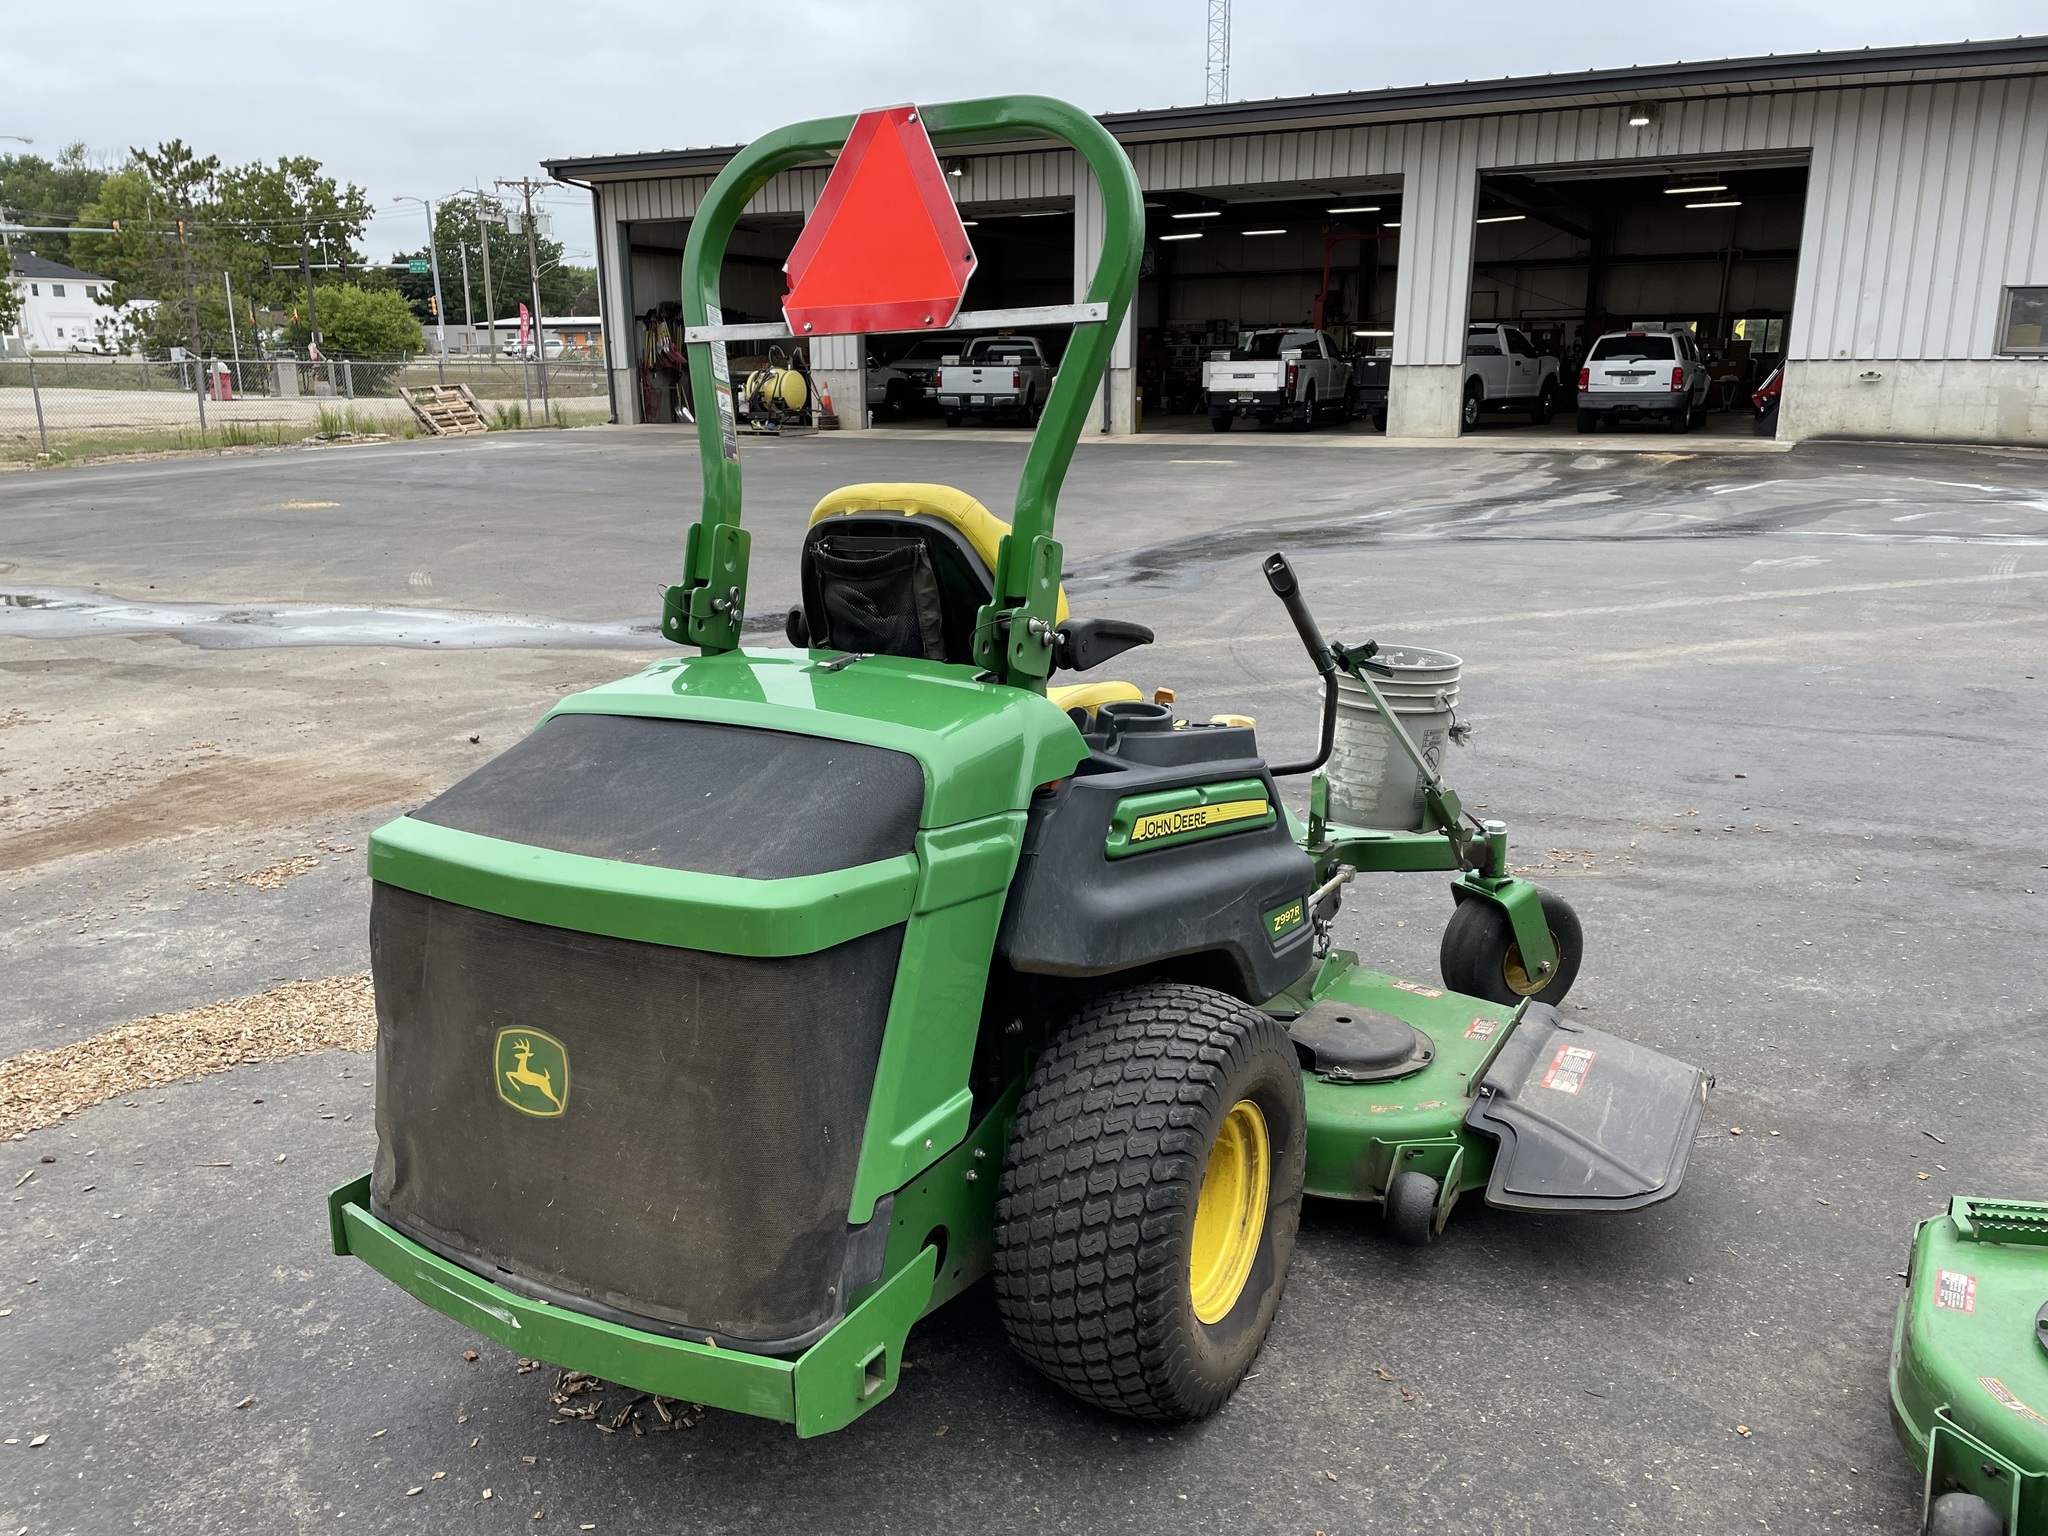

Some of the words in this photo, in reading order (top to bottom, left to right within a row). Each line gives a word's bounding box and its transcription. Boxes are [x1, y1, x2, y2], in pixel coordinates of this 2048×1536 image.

[1140, 818, 1171, 838] JOHN
[1173, 811, 1207, 830] DEERE
[1274, 905, 1300, 932] Z997R
[1284, 1128, 1302, 1239] KENDA
